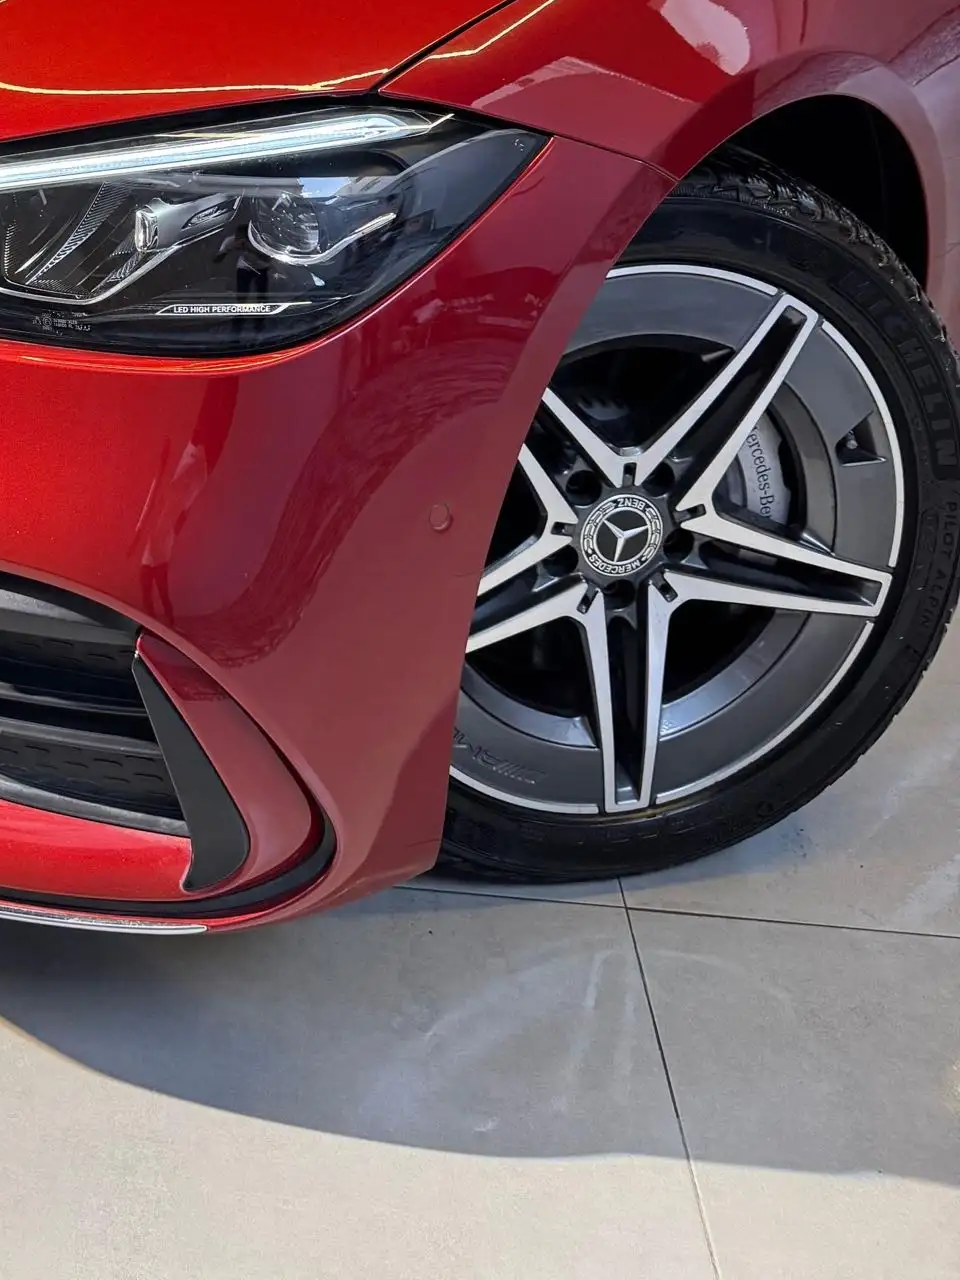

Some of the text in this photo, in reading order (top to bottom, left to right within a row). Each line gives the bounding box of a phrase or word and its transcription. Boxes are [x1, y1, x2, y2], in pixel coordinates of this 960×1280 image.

[746, 426, 775, 519] ercedes-Be
[617, 498, 646, 510] BENZ
[940, 501, 958, 559] PILOT
[589, 554, 641, 574] MERCEDES
